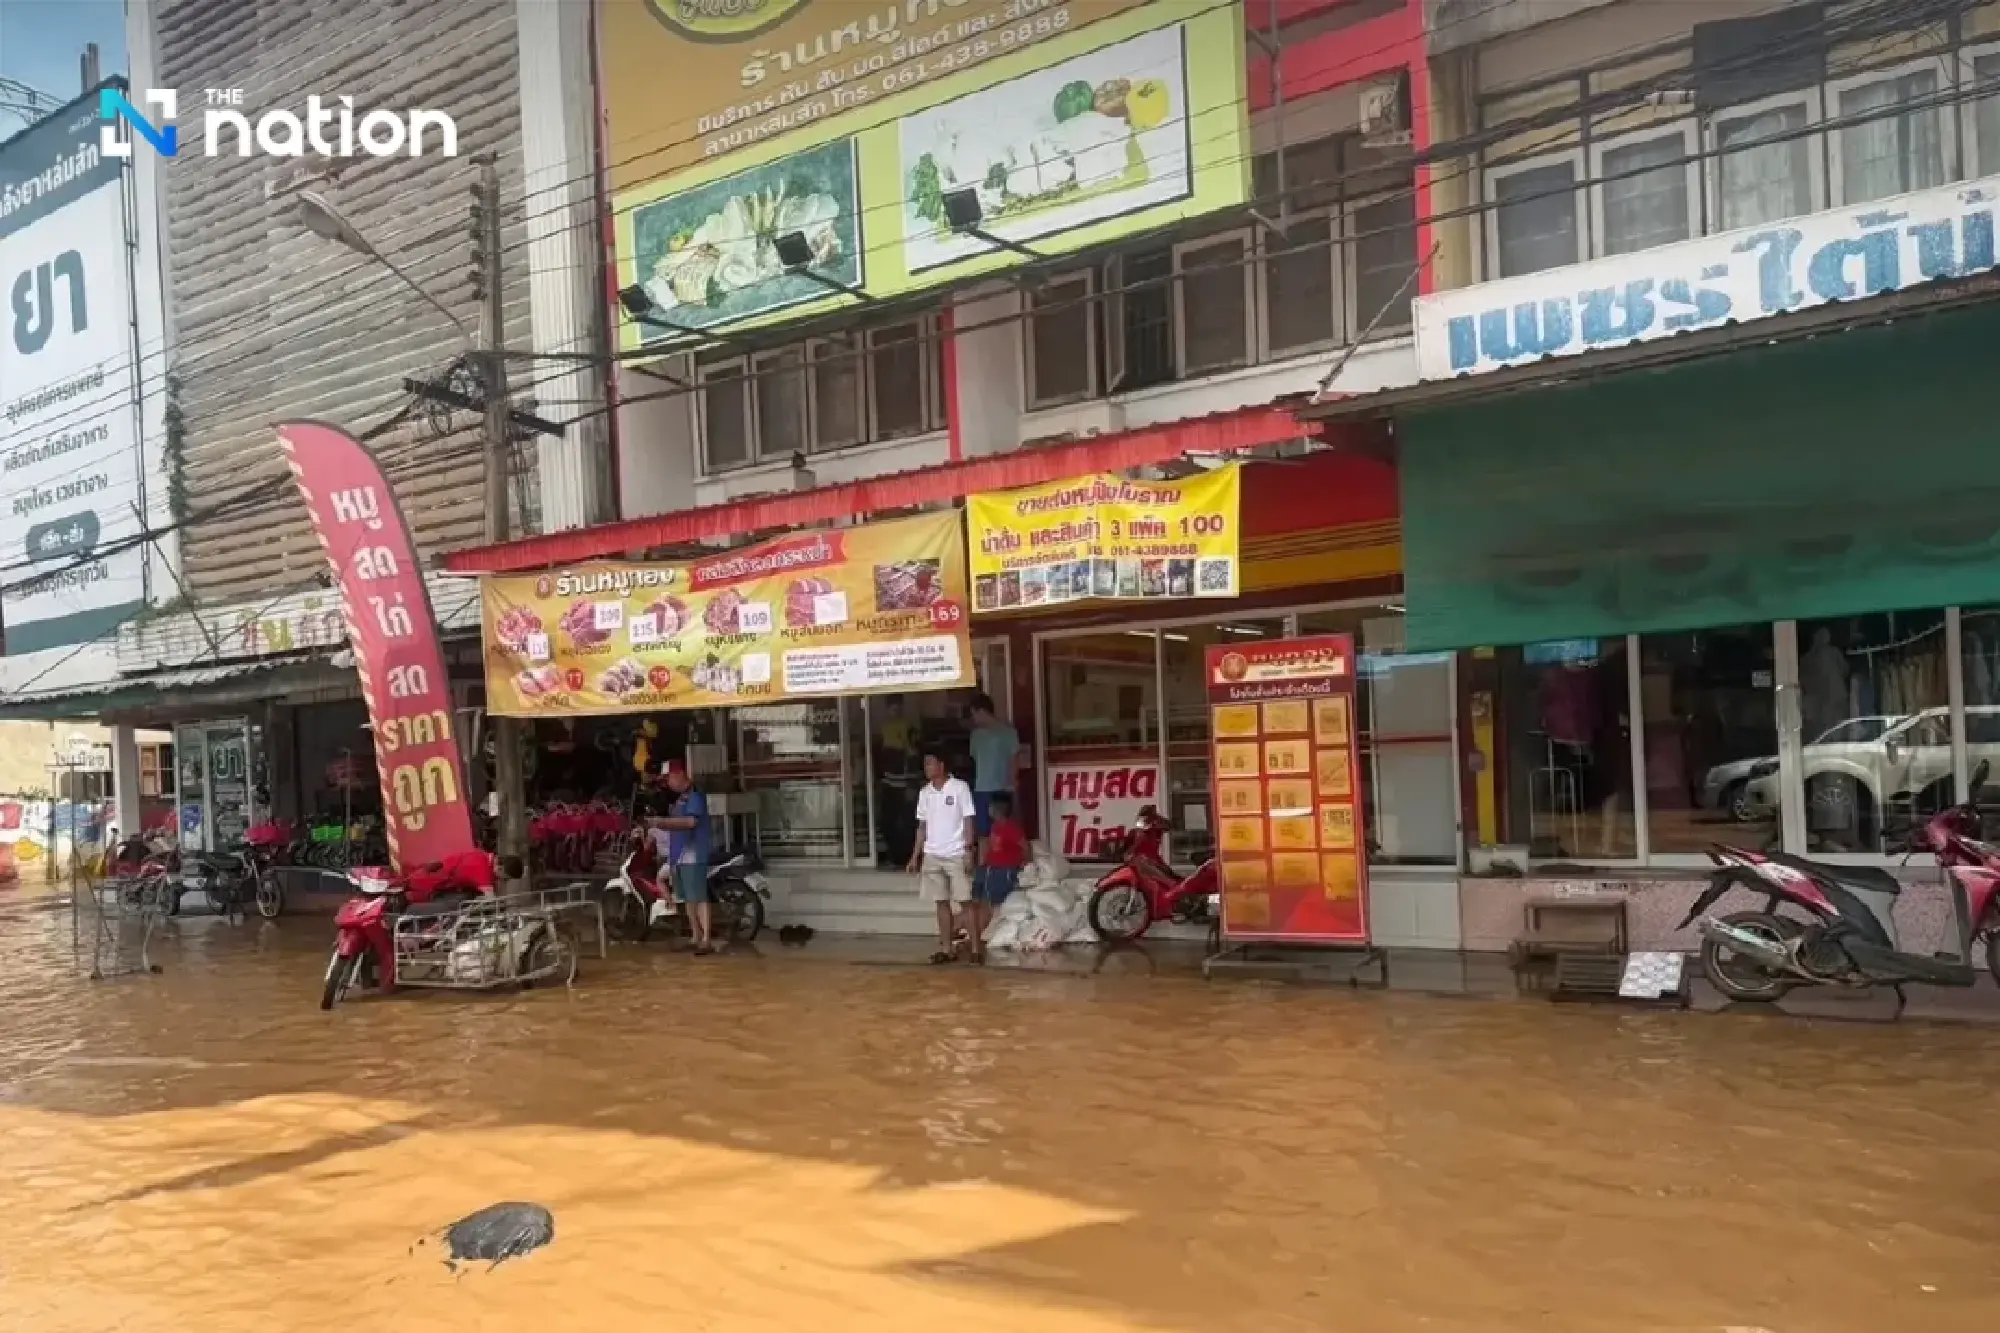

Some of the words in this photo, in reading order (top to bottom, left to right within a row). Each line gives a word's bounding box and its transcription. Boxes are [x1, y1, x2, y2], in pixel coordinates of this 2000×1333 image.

[0, 142, 99, 218] ลังยาหล่มสัก
[11, 249, 88, 354] ยา
[330, 486, 384, 531] หมู
[1110, 519, 1121, 539] 3
[1179, 513, 1225, 538] 100
[353, 545, 400, 581] สด
[555, 567, 676, 597] ร้านหมูทอง
[368, 593, 414, 638] ไก่
[928, 604, 961, 622] 169
[386, 664, 429, 698] สด
[382, 708, 452, 752] ราคา
[392, 755, 458, 832] ถูก
[1053, 767, 1157, 810] หมูสด
